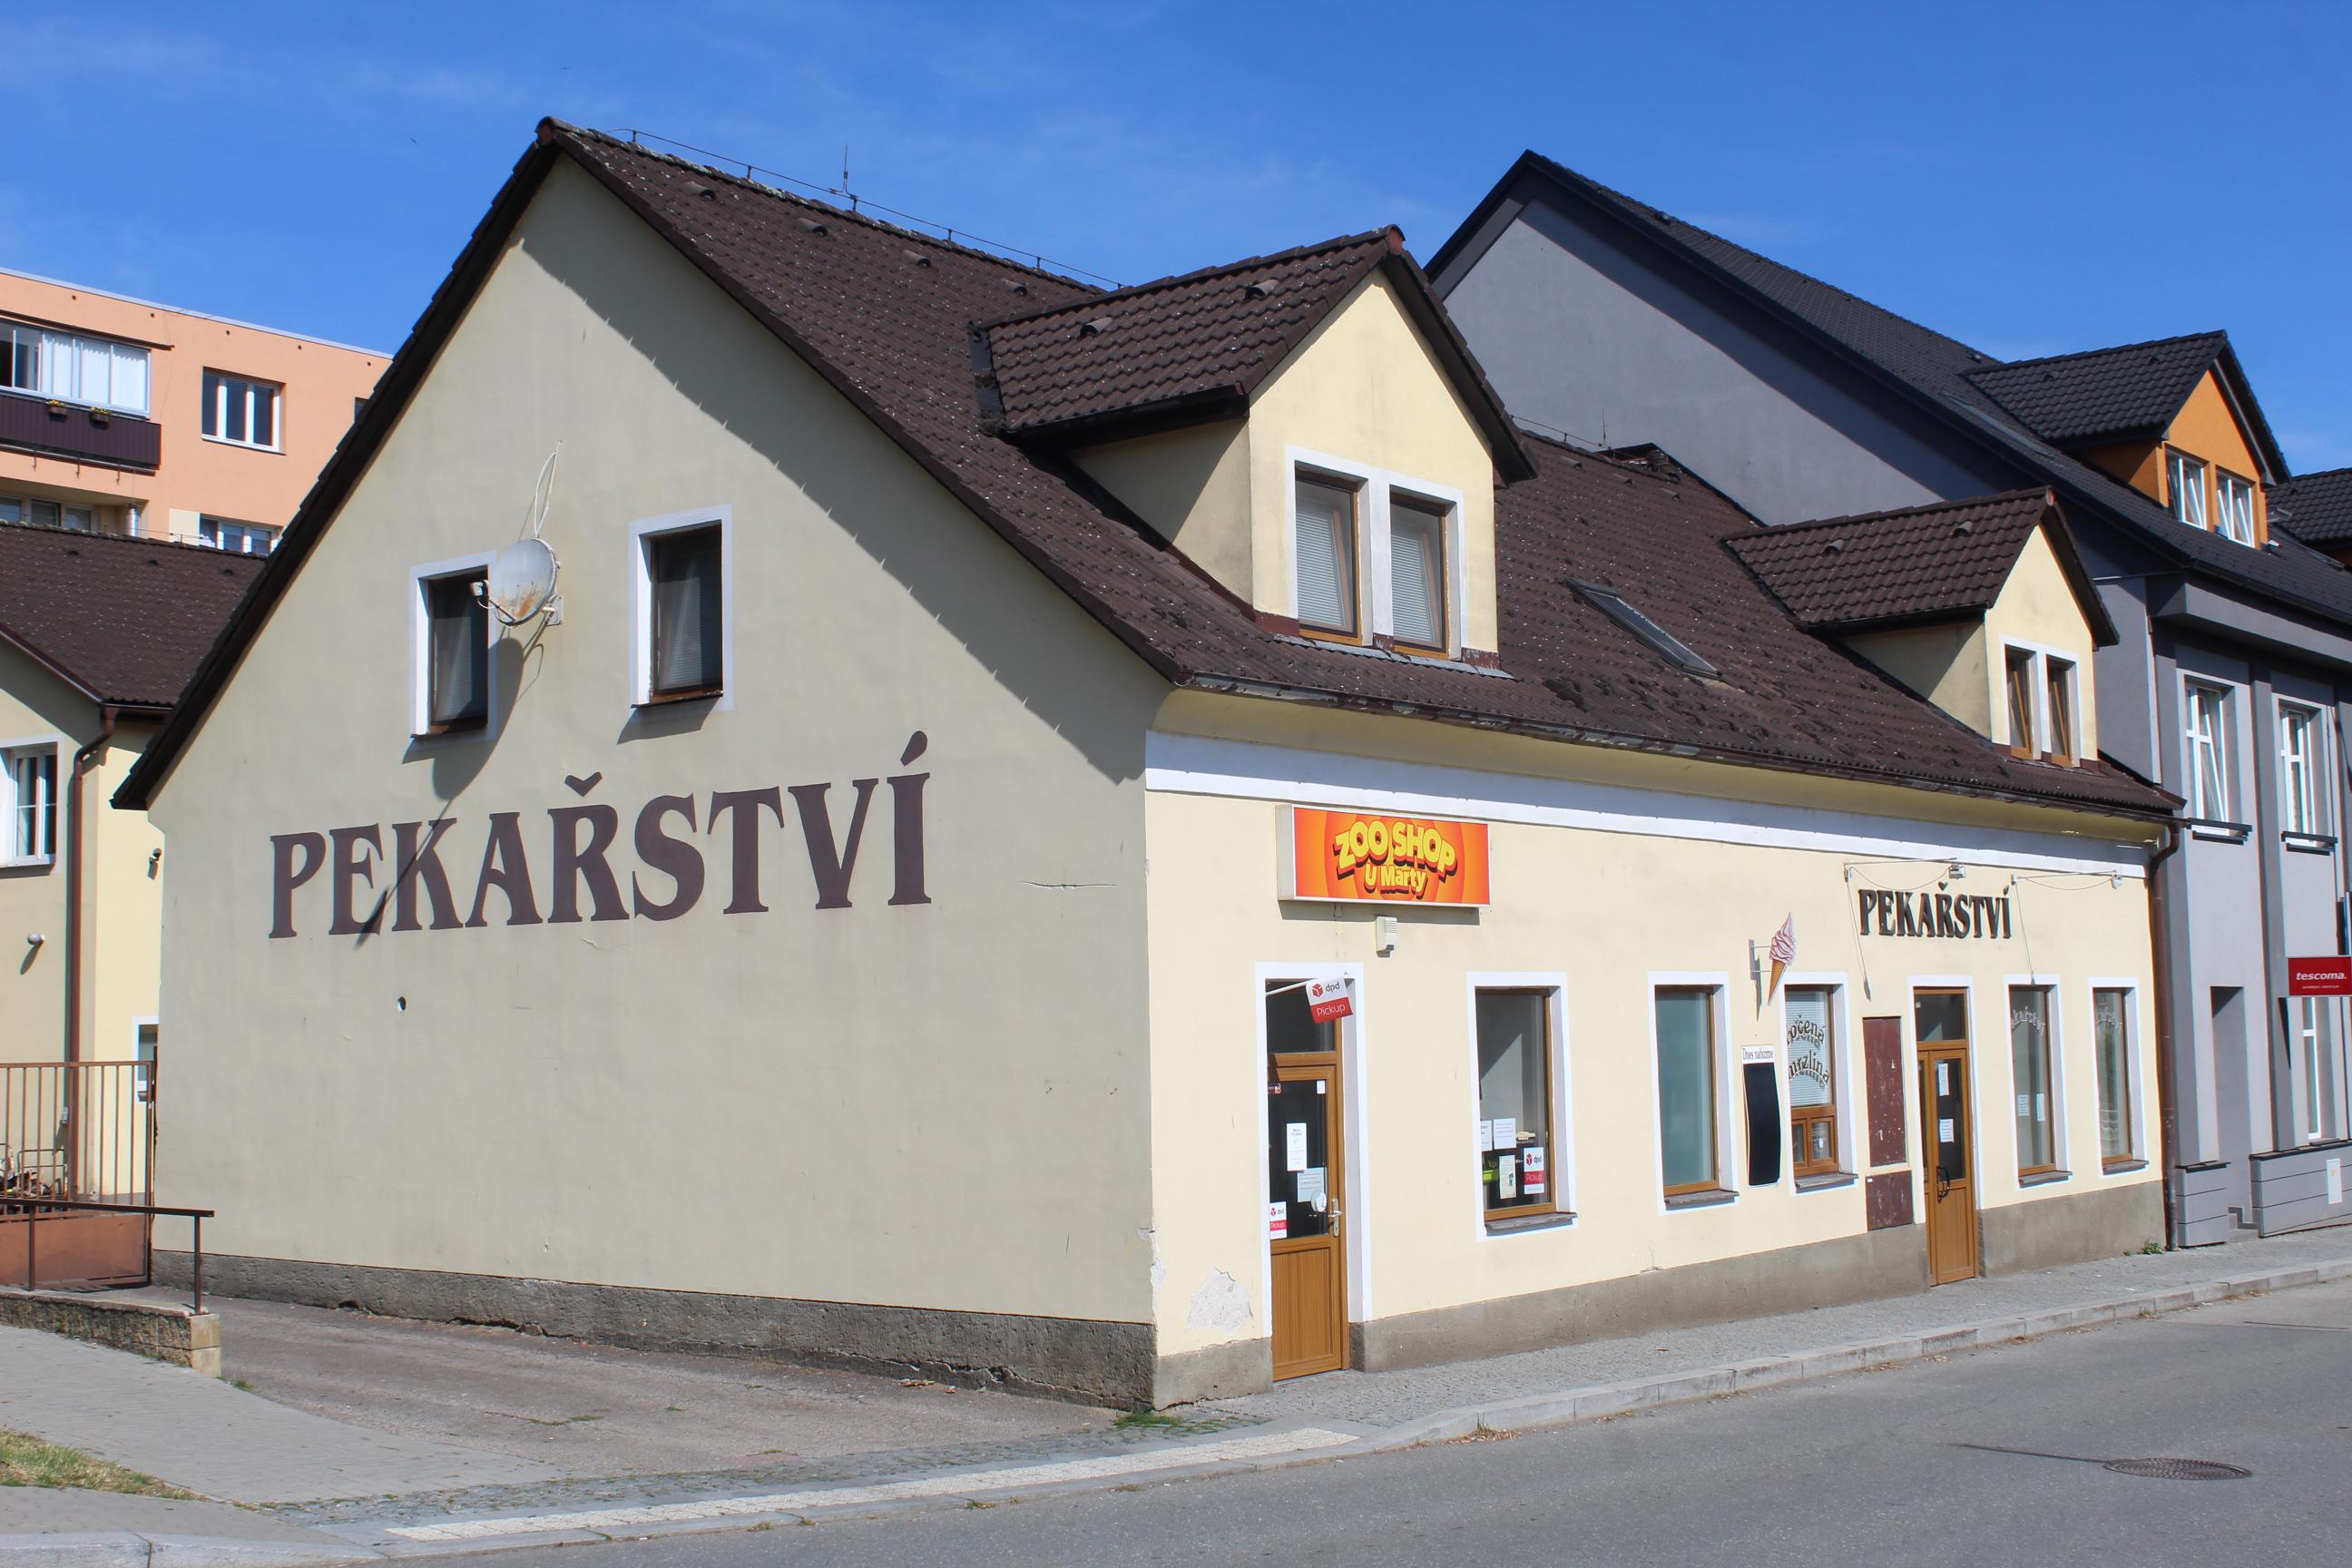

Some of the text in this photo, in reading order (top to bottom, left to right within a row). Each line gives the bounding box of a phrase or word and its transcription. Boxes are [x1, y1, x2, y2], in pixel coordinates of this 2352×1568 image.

[269, 730, 932, 939] PEKAŘSTVÍ
[1335, 820, 1456, 874] ZOO SHOP
[1365, 863, 1427, 893] U Marty
[1857, 881, 2012, 939] PEKAŘSTVÍ
[1325, 981, 1341, 993] dpd
[1317, 1004, 1346, 1017] Pickup
[1788, 1049, 1829, 1086] mrzlina
